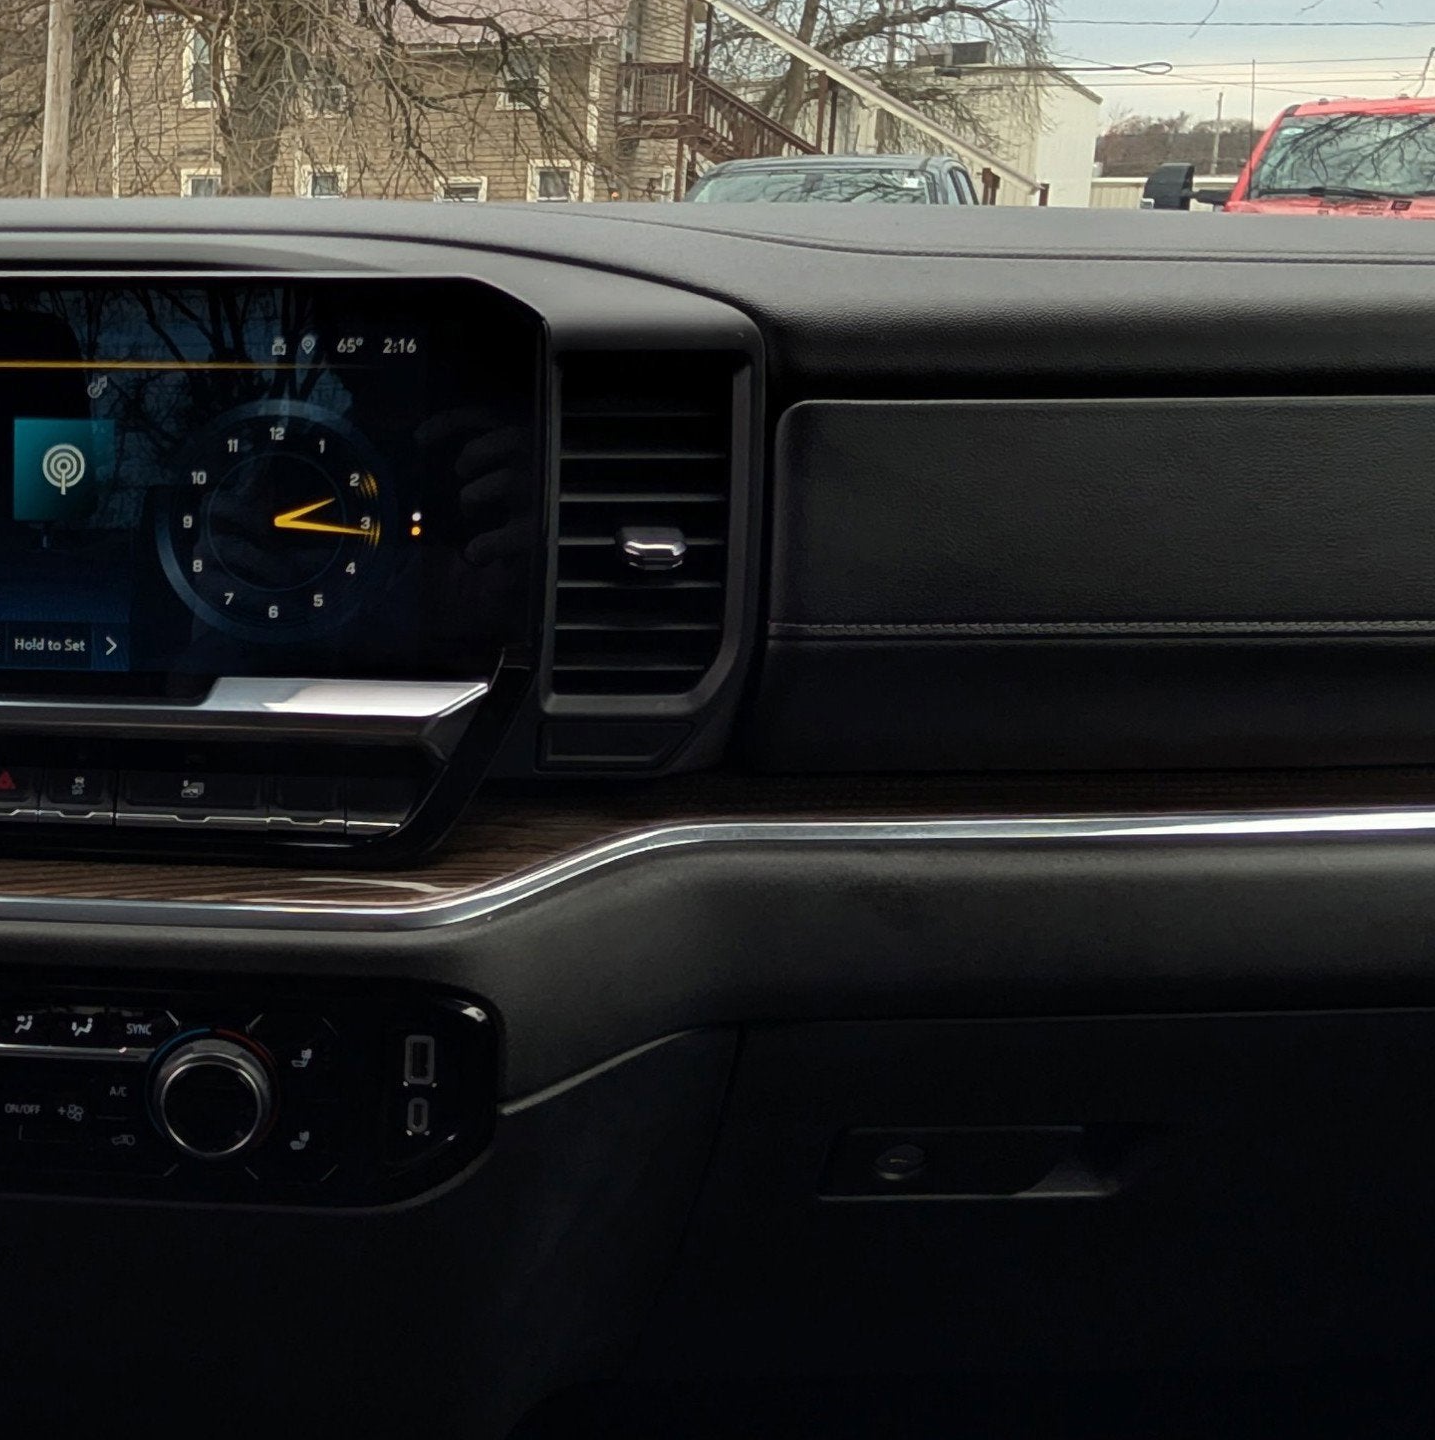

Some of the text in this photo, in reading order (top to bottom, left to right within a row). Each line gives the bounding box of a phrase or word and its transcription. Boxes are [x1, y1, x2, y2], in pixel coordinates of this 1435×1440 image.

[382, 338, 417, 354] 2:16
[268, 426, 285, 441] 12
[190, 471, 208, 486] 10
[14, 638, 86, 652] Hold to Set
[126, 1022, 152, 1036] SYNC
[109, 1085, 128, 1098] A/C
[4, 1102, 42, 1116] ON/OFF
